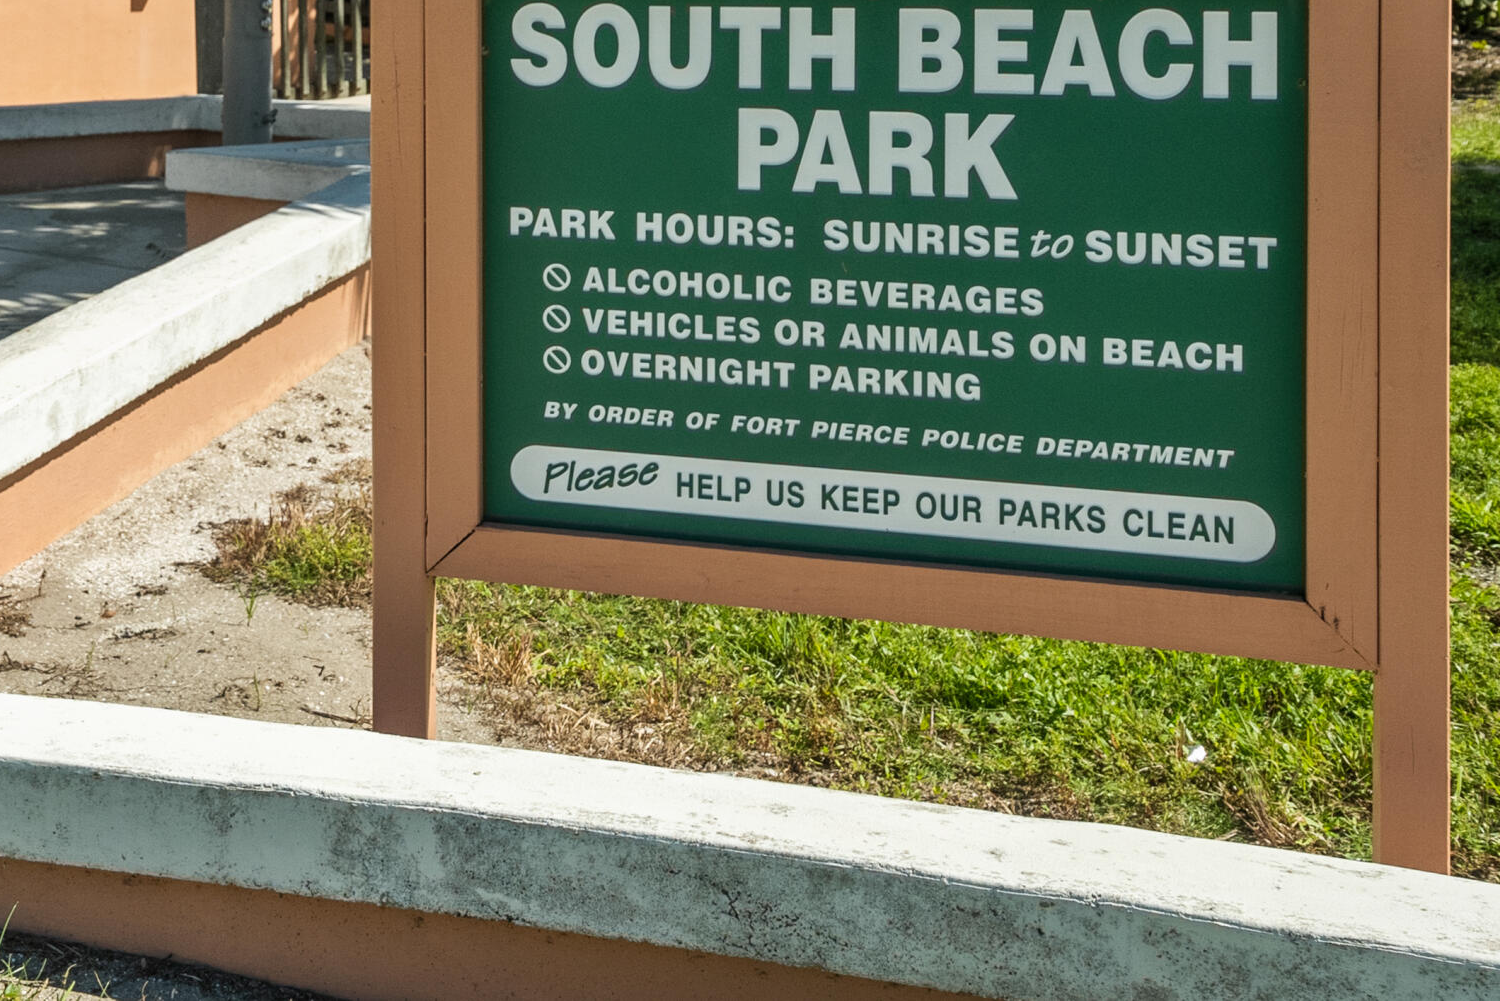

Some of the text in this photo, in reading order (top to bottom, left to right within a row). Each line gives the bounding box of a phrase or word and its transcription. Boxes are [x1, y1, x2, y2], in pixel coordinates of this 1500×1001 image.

[511, 3, 1277, 99] SOUTH BEACH
[738, 108, 1017, 199] PARK
[510, 207, 1277, 268] PARK HOURS: SUNRISE to SUNSET
[583, 267, 1043, 316] ALCOHOLIC BEVERAGES
[582, 308, 1242, 371] VEHICLES OR ANIMALS ON BEACH
[581, 349, 980, 400] OVERNIGHT PARKING
[544, 402, 1234, 467] BY ORDER OF FORT PIERCE POLICE DEPARTMENT
[544, 461, 1233, 544] Please HELP US KEEP OUR PARKS CLEAN
